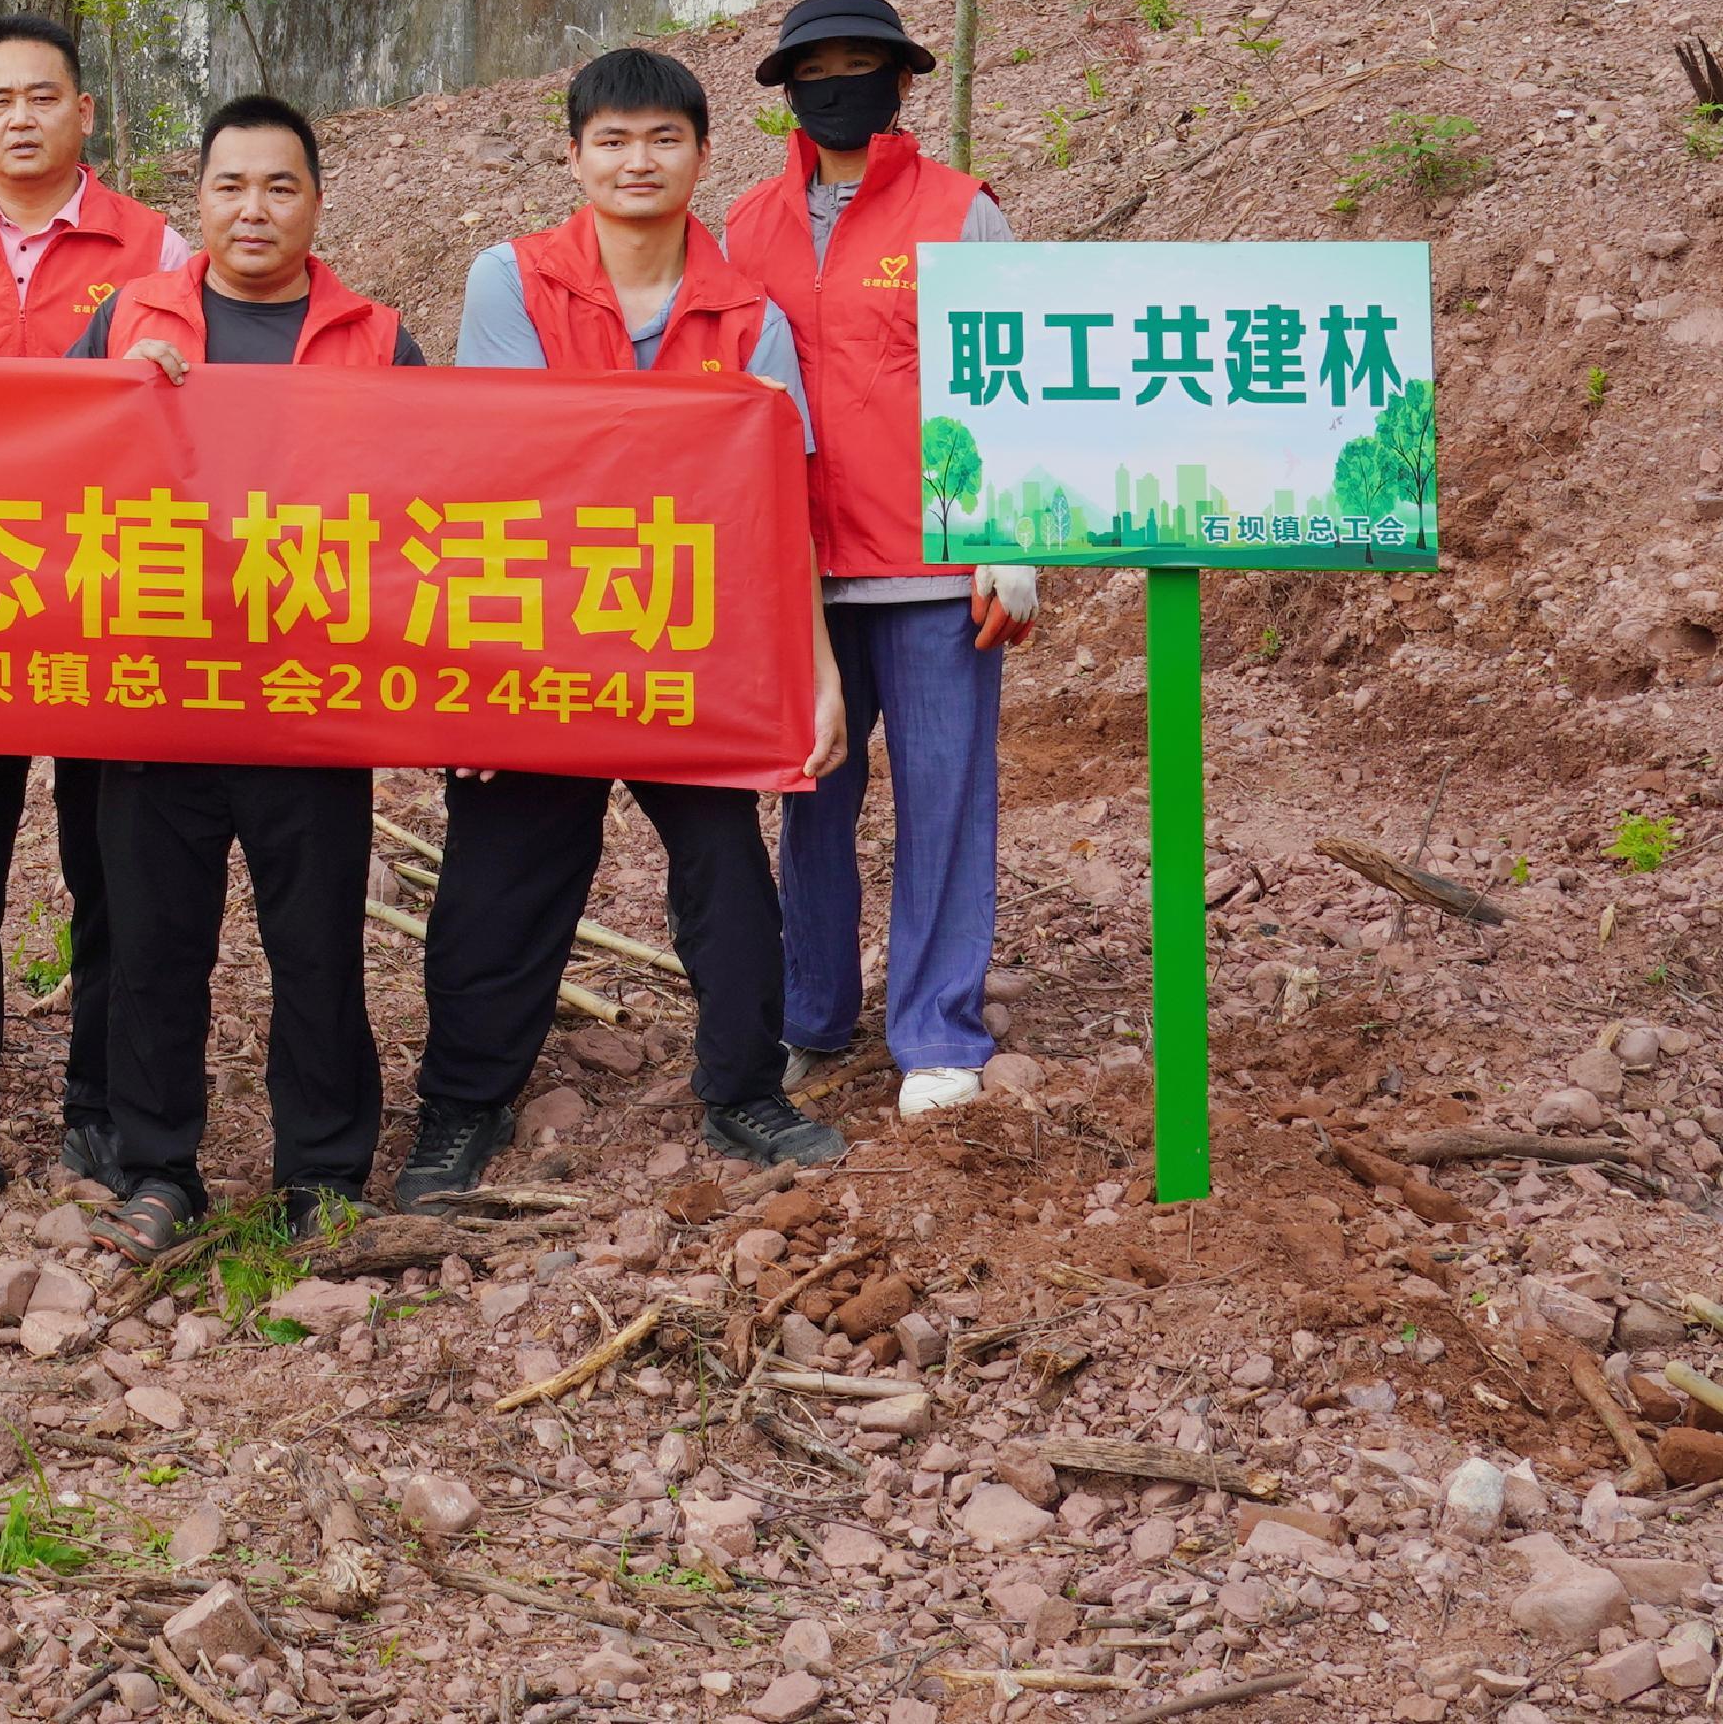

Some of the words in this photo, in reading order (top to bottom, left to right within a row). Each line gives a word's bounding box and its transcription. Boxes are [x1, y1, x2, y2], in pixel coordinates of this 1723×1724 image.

[947, 304, 1402, 407] 职工共建林
[1202, 515, 1406, 544] 石坝镇总工会
